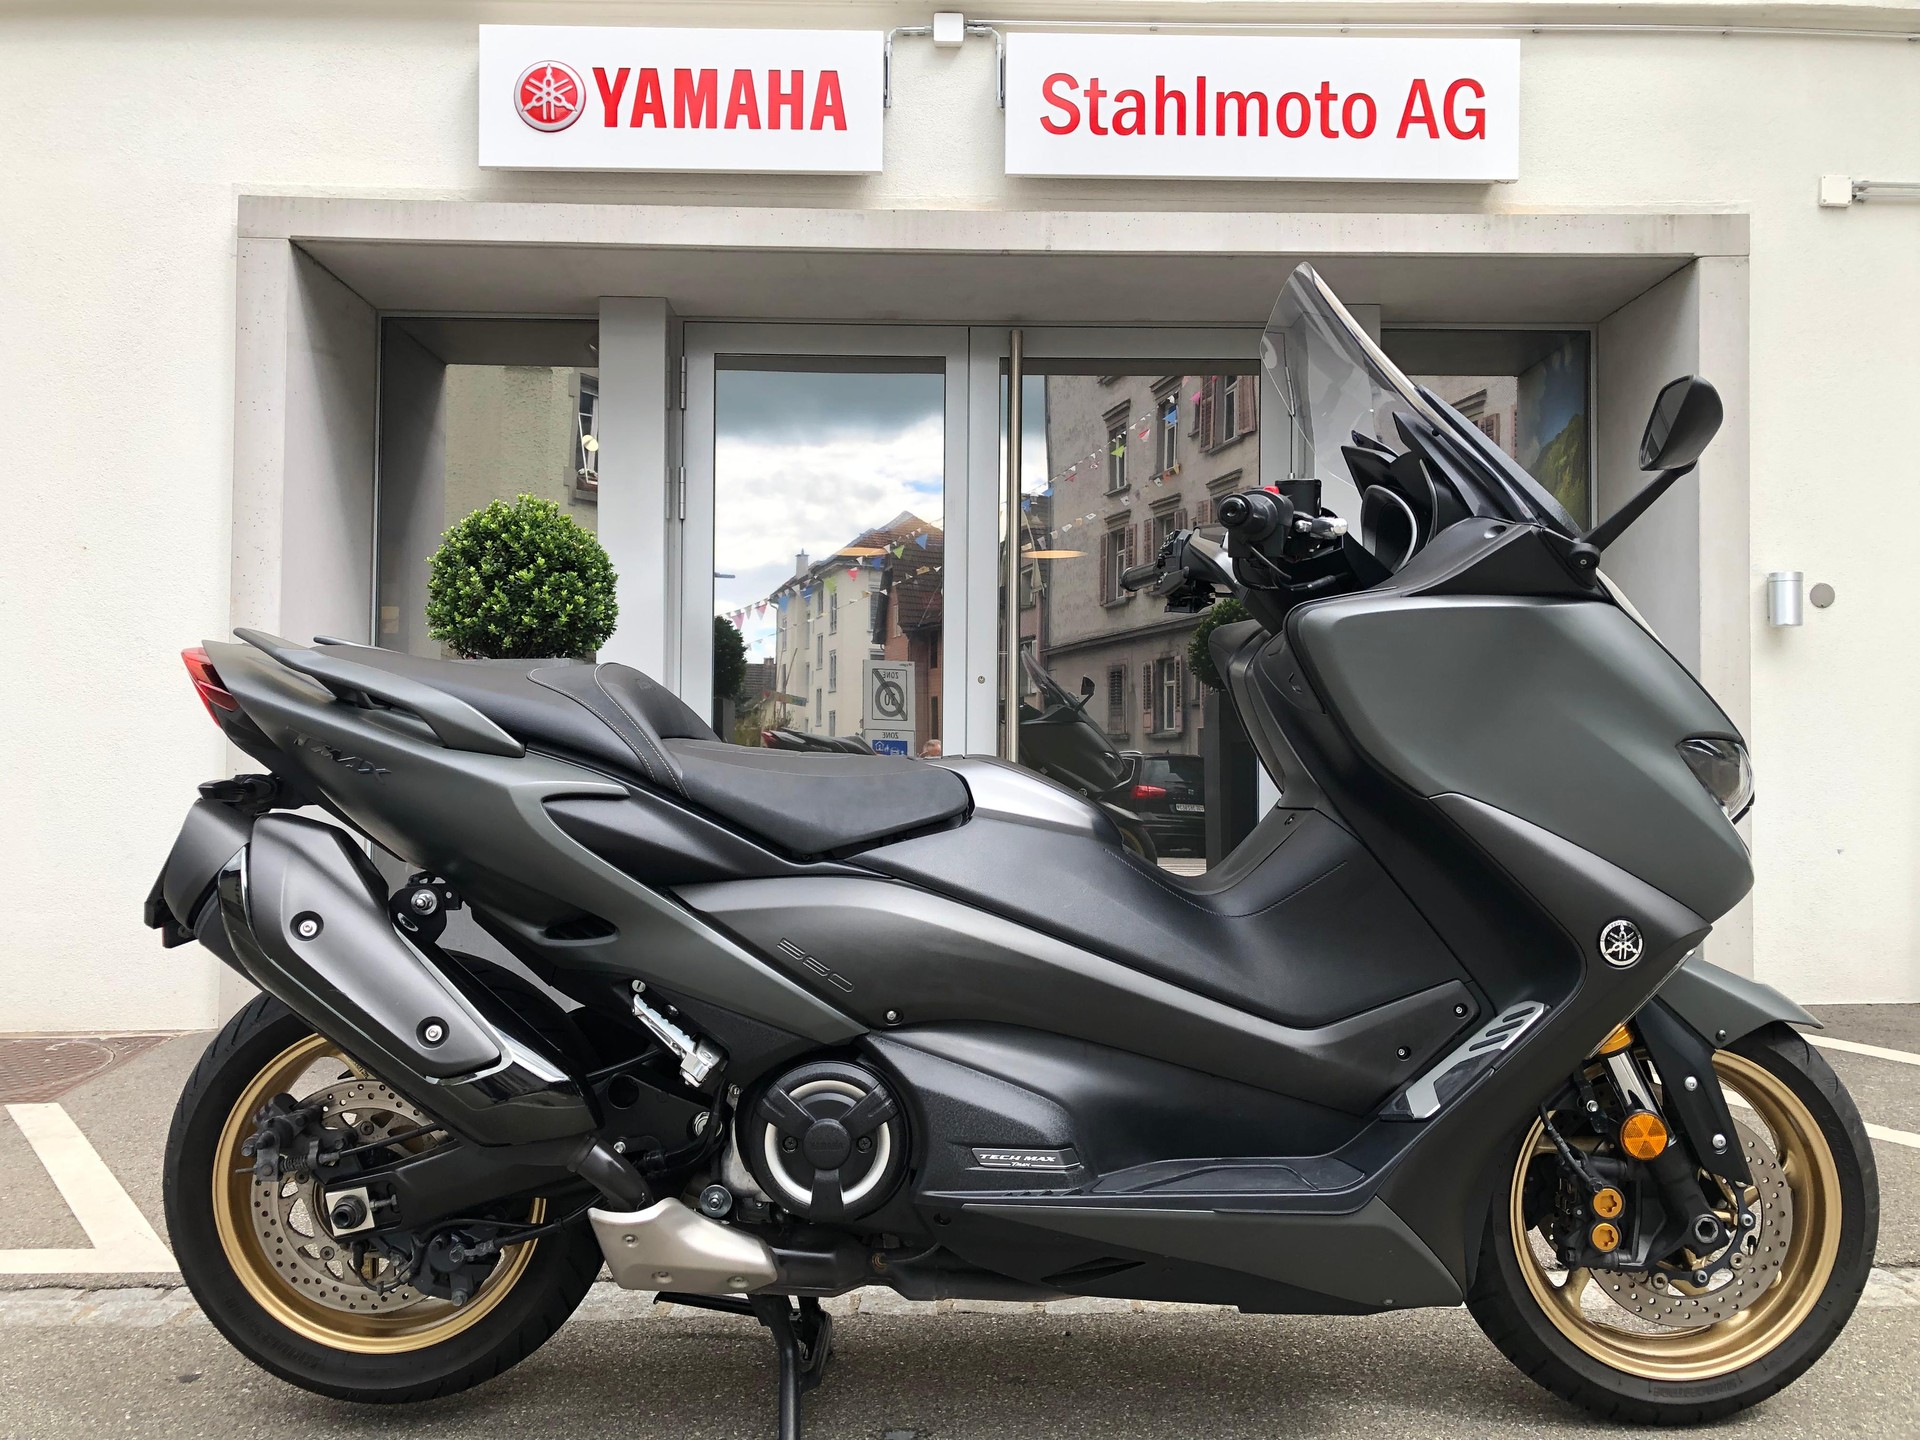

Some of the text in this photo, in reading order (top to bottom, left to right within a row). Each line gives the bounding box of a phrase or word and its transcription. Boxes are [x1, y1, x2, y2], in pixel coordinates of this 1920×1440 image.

[592, 67, 848, 131] YAMAHA
[1039, 72, 1487, 140] Stahlmoto AG
[979, 1153, 1020, 1161] TECH
